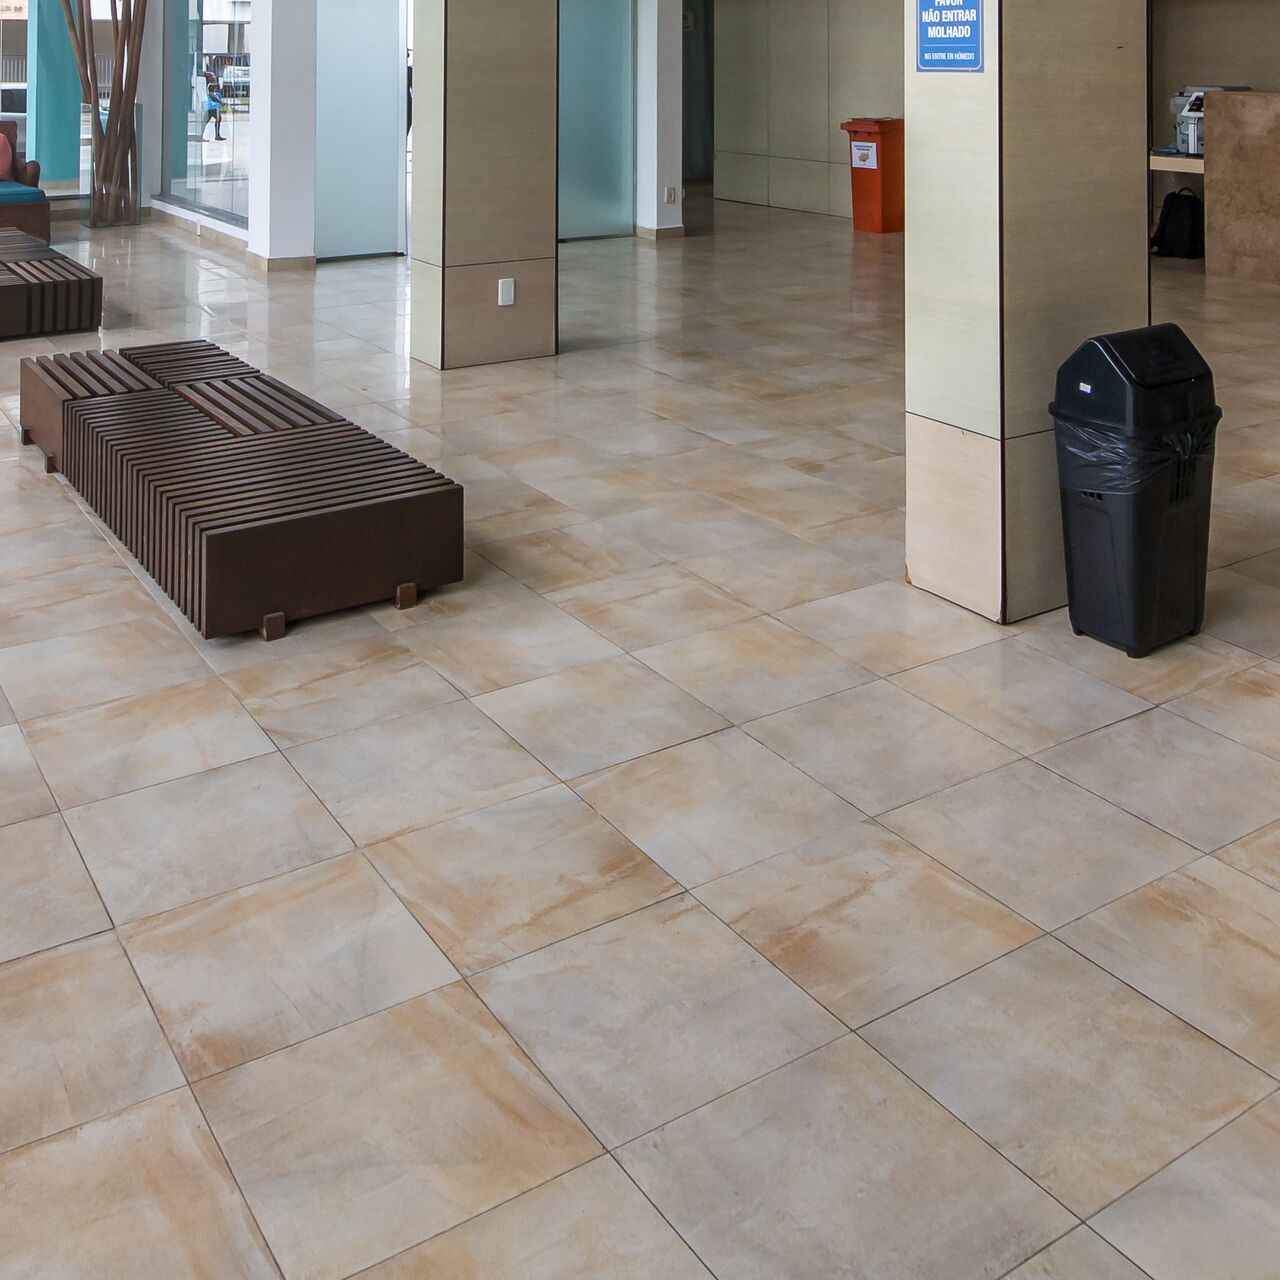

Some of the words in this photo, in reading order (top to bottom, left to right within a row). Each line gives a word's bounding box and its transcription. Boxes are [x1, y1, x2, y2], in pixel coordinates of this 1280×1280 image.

[922, 9, 940, 23] NÃO
[941, 9, 977, 22] ENTRAR
[927, 25, 971, 38] MOLHADO
[924, 52, 932, 60] NO
[932, 52, 946, 60] ENTRE
